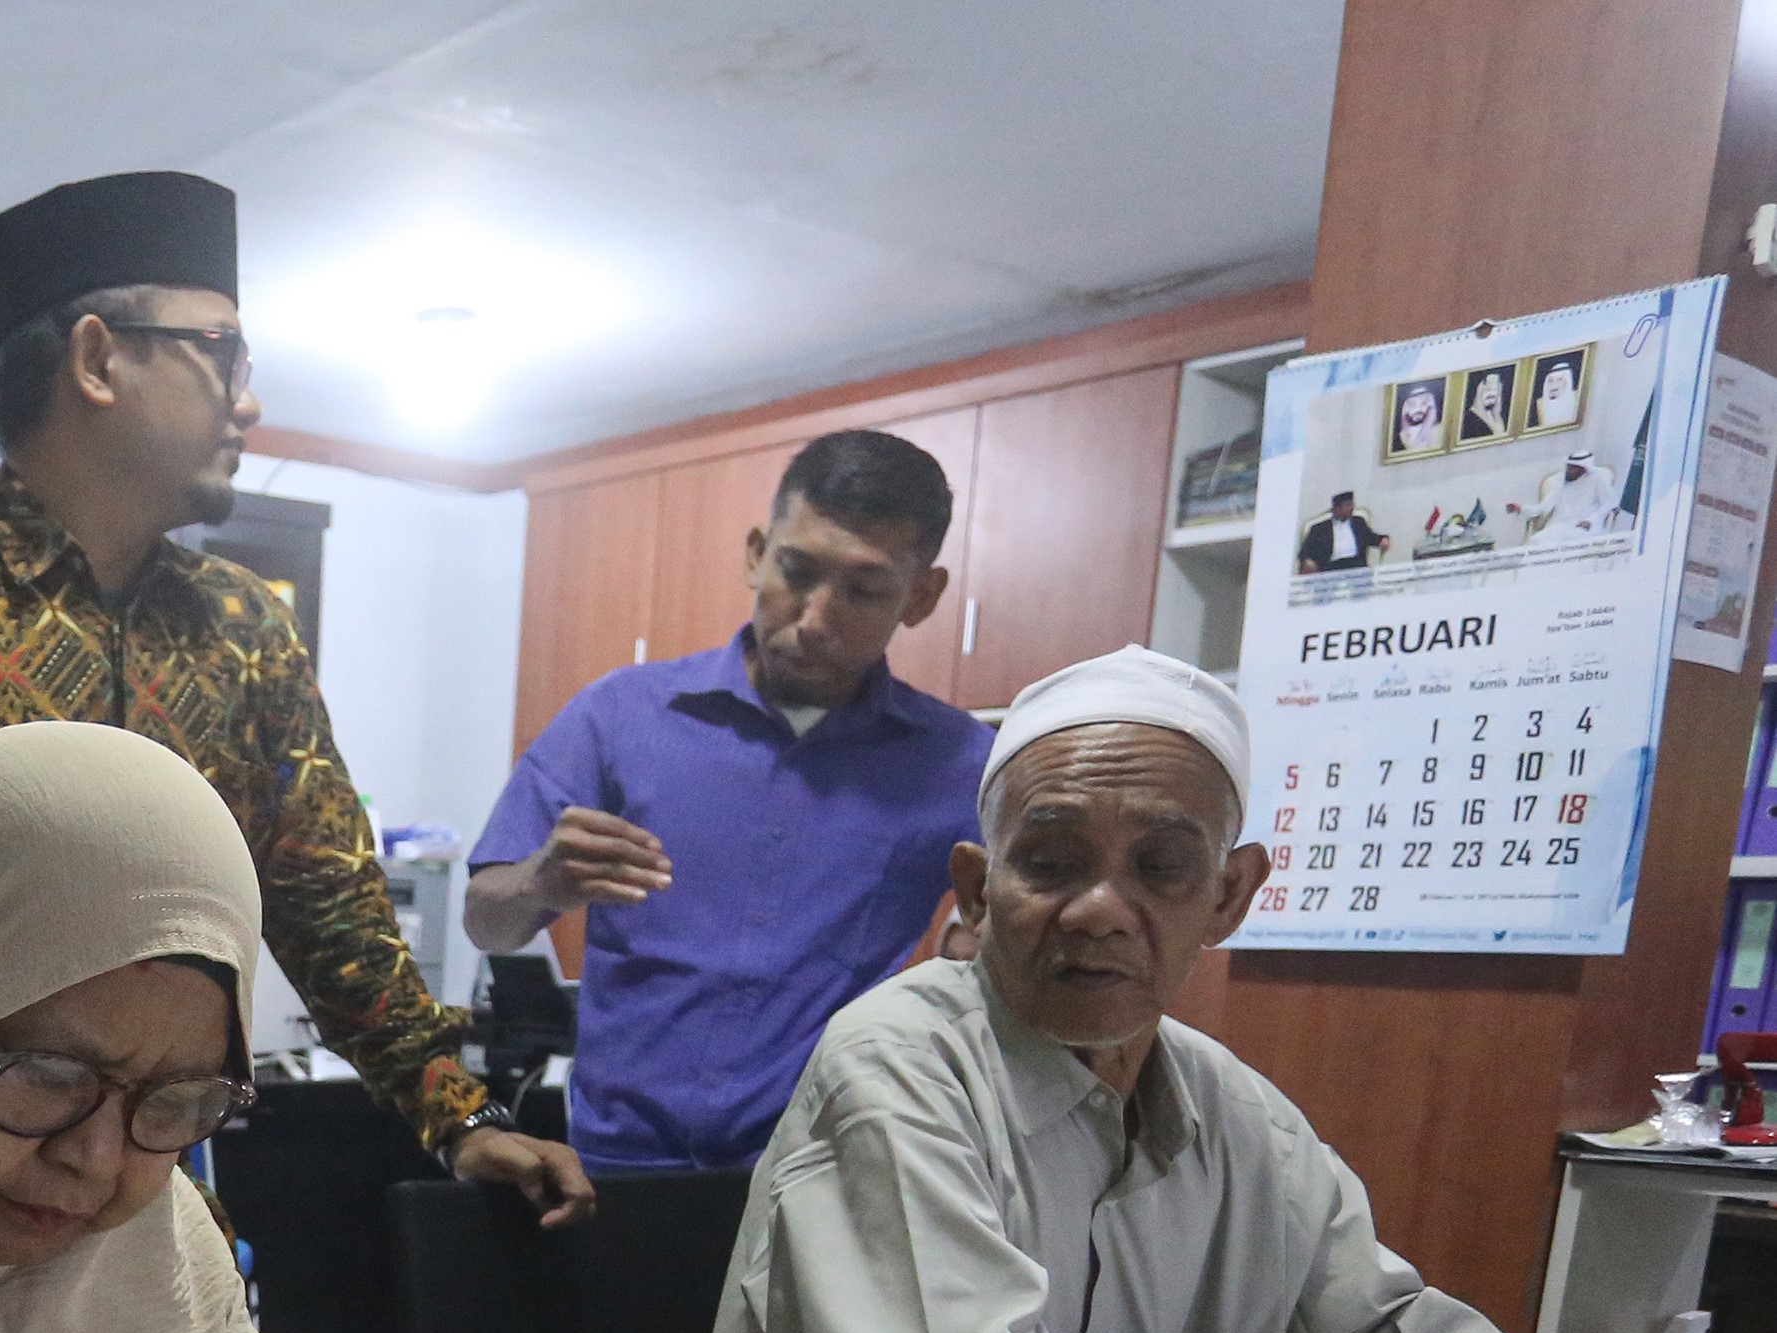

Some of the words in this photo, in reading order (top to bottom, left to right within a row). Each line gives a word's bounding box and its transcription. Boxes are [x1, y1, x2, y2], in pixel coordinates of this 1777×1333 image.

[1300, 614, 1497, 663] FEBRUARI
[1419, 683, 1452, 695] Rabu
[1470, 678, 1507, 691] Kamis
[1516, 674, 1560, 687] Jum'at
[1569, 669, 1609, 683] Sabtu
[1431, 717, 1440, 743] 1
[1472, 714, 1489, 741] 2
[1526, 710, 1543, 738] 3
[1576, 706, 1592, 734] 4
[1285, 764, 1300, 790] 5
[1326, 762, 1341, 789] 6
[1379, 759, 1393, 785] 7
[1422, 757, 1438, 784] 8
[1470, 753, 1486, 781] 9
[1516, 752, 1544, 781] 10
[1568, 748, 1586, 776] 11
[1274, 806, 1296, 833] 12
[1318, 806, 1341, 832] 13
[1366, 802, 1387, 829] 14
[1412, 800, 1436, 827] 15
[1461, 798, 1485, 826] 16
[1513, 795, 1538, 823] 17
[1557, 794, 1588, 824] 18
[1272, 845, 1292, 871] 19
[1307, 844, 1336, 871] 20
[1359, 842, 1383, 869] 21
[1401, 841, 1432, 868] 22
[1451, 841, 1483, 868] 23
[1500, 839, 1532, 866] 24
[1545, 837, 1581, 865] 25
[1259, 886, 1288, 911] 26
[1299, 886, 1329, 912] 27
[1349, 885, 1380, 912] 28
